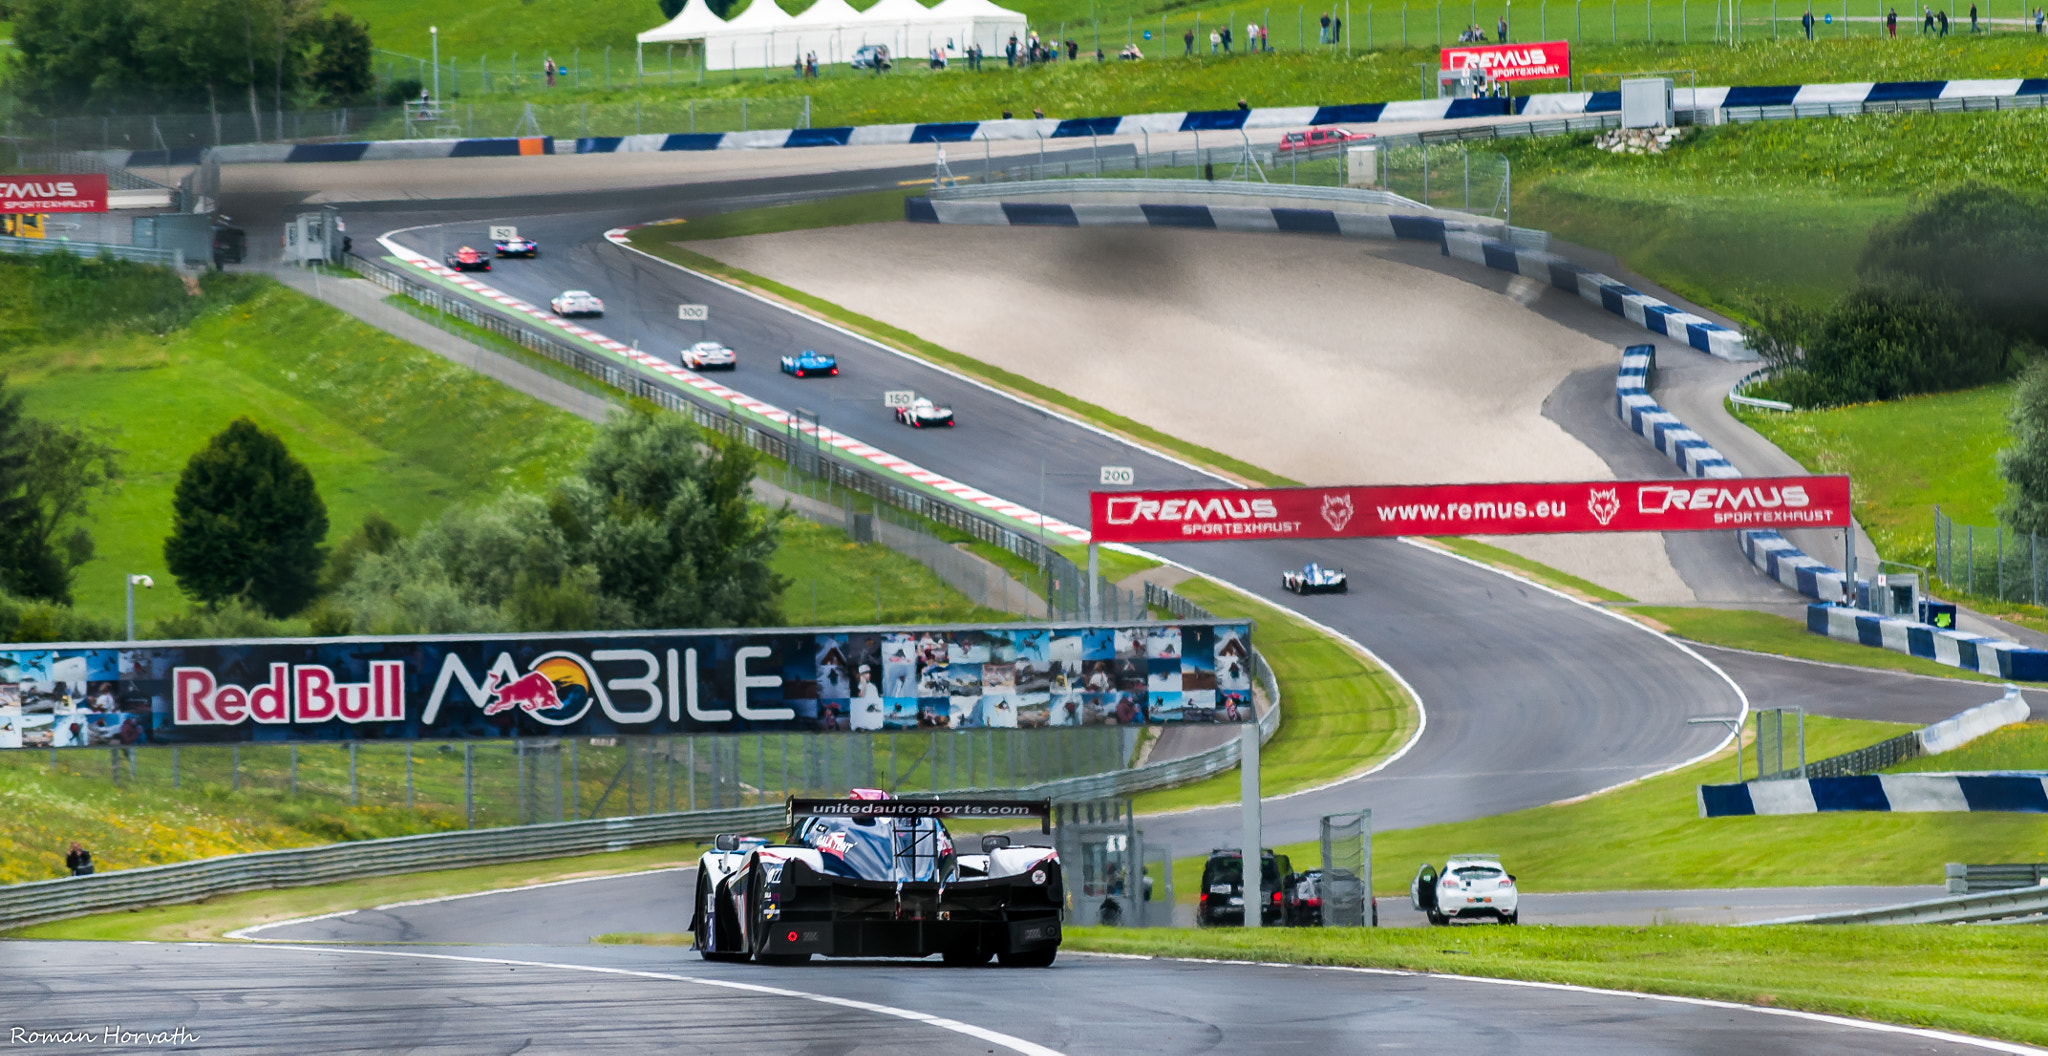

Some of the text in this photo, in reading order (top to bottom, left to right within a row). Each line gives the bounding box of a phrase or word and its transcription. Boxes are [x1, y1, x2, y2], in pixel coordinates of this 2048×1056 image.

[1465, 49, 1547, 69] REMUS
[4, 200, 96, 209] SPORTEXHAUST
[683, 307, 704, 318] 100
[889, 394, 910, 404] 150
[1104, 470, 1130, 481] 200
[1663, 486, 1810, 511] REMUS
[1132, 498, 1278, 521] REMUS
[1376, 500, 1567, 522] www.remus.eu
[1714, 509, 1834, 524] SPORTEXHAUST
[1182, 521, 1301, 535] SPORTEXHAUST
[173, 646, 796, 726] Red Bull MOBILE
[812, 803, 1031, 816] unitedautosports.com
